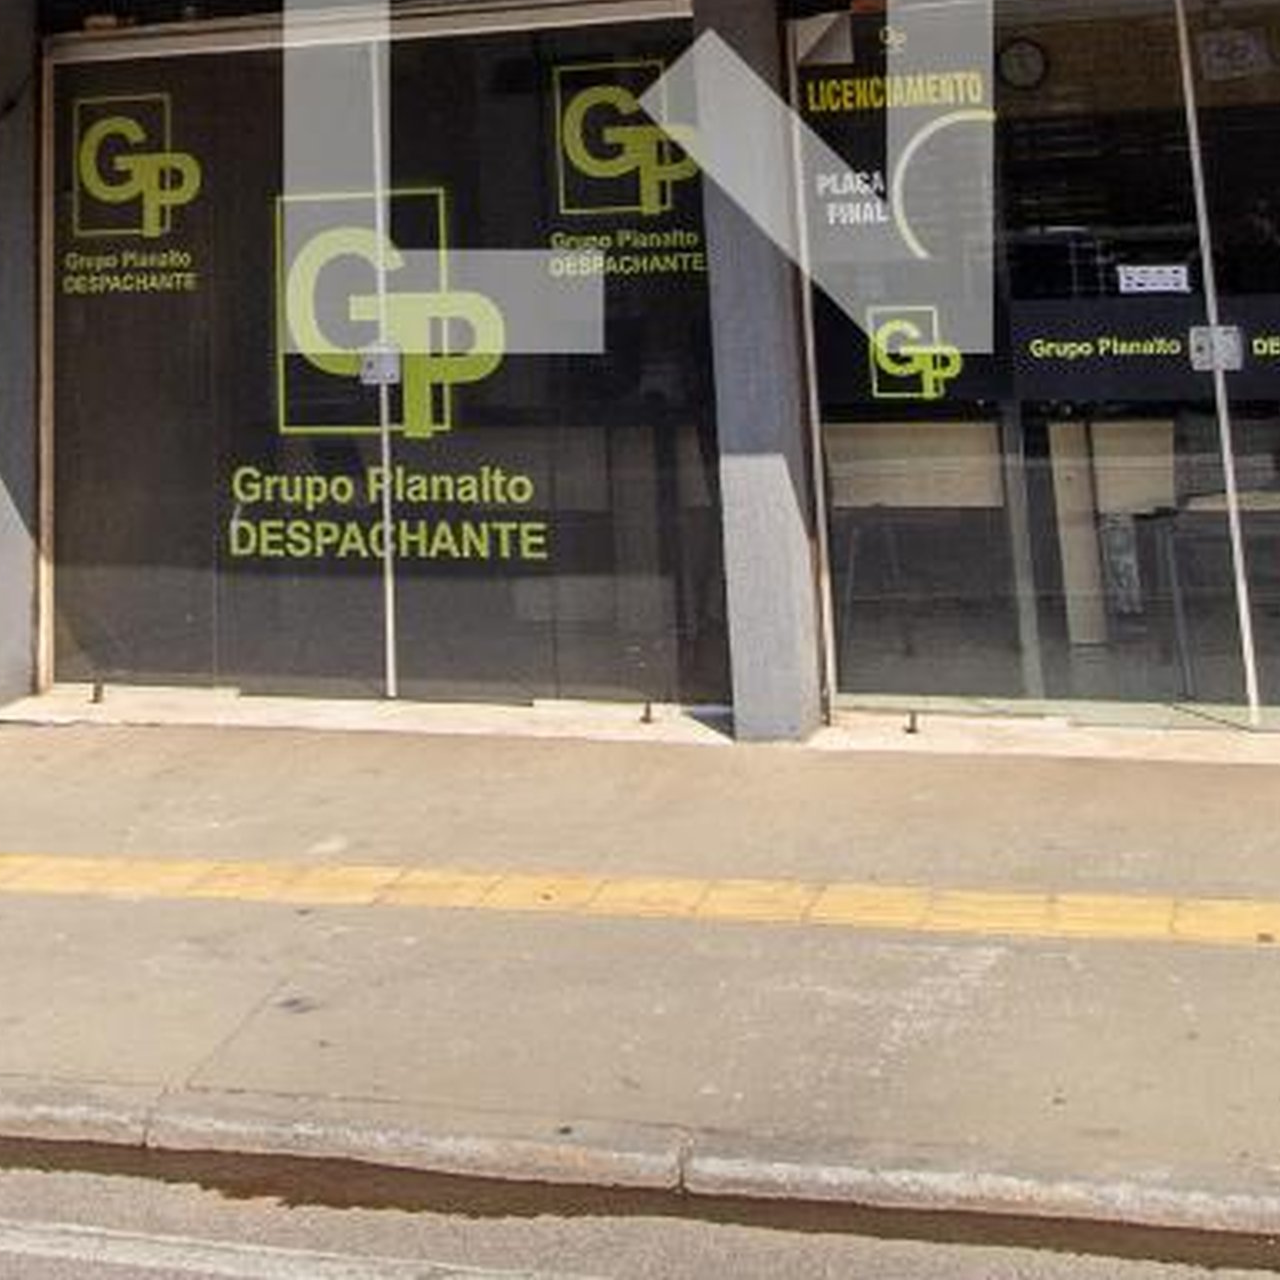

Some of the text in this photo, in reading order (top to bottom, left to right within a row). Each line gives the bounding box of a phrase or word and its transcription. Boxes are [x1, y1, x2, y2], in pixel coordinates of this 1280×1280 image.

[807, 71, 982, 111] LICENCIAMENTO
[549, 252, 708, 275] DESPACHANTE
[62, 272, 198, 294] DESPACHANTE
[1030, 338, 1093, 359] Grupo
[1099, 337, 1182, 357] Planalto
[231, 465, 534, 510] Grupo Planalto
[229, 519, 548, 560] DESPACHANTE
